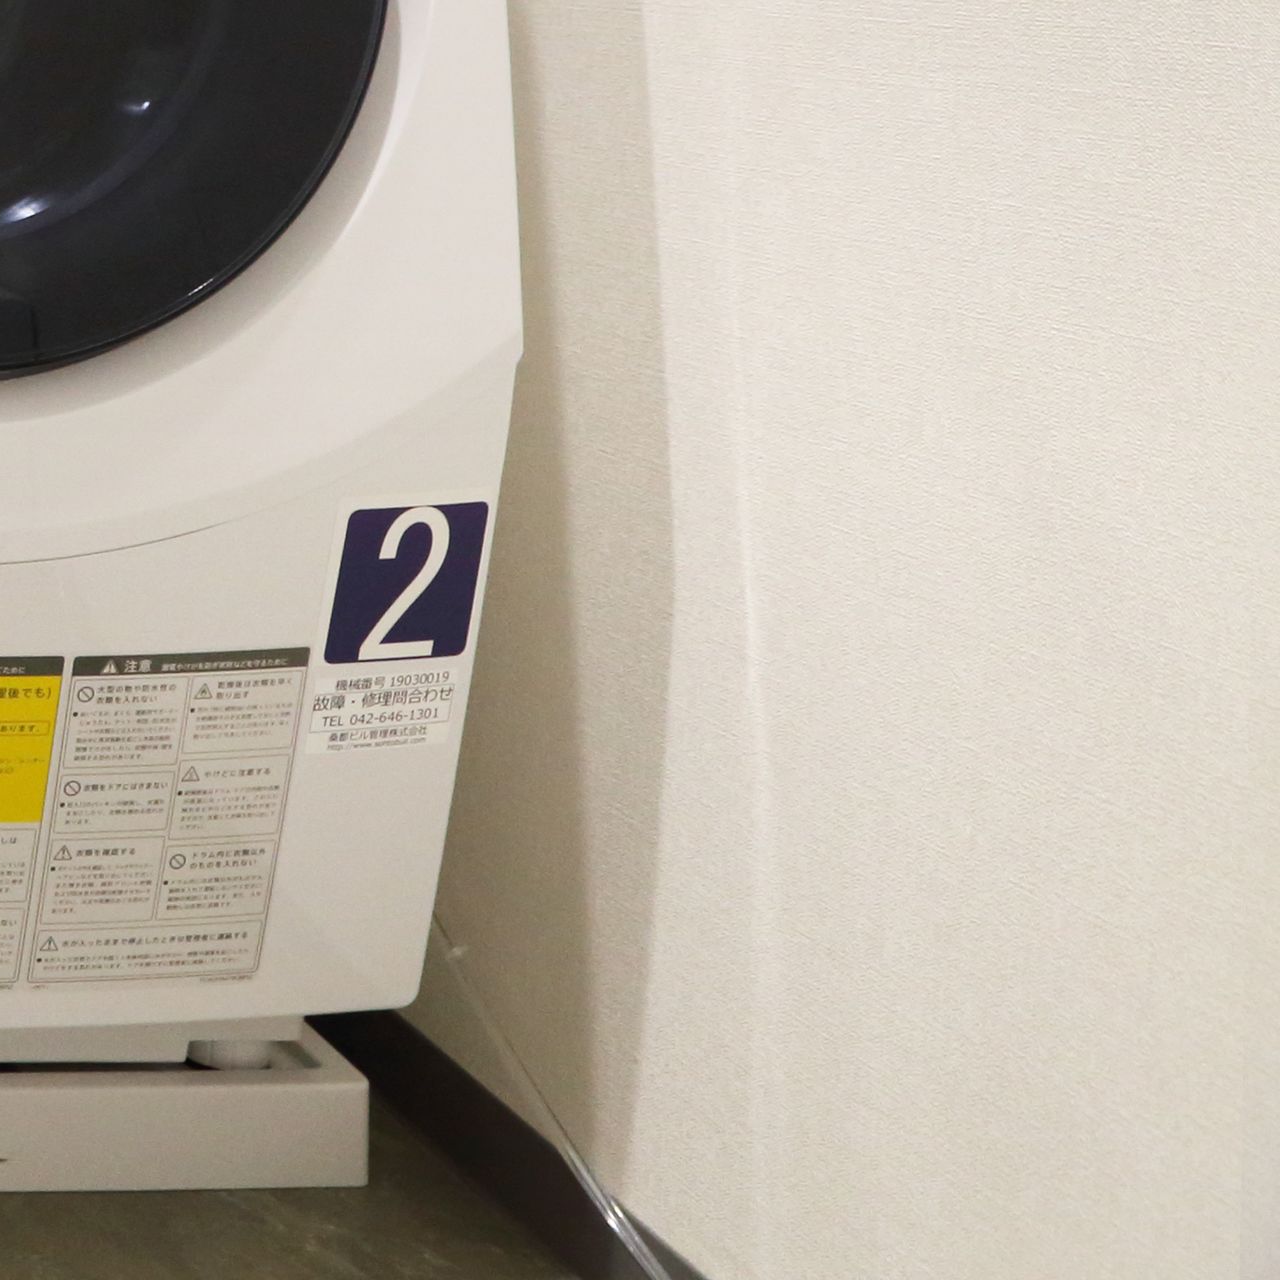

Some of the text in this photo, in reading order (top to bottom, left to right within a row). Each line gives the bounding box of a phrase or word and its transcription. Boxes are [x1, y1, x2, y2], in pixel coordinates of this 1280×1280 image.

[357, 505, 451, 661] 2
[124, 659, 153, 673] 注意
[335, 671, 450, 692] 機械番号 19030019
[312, 686, 454, 712] 故障・修理問合わせ
[322, 708, 439, 727] TEL 042-646-1301
